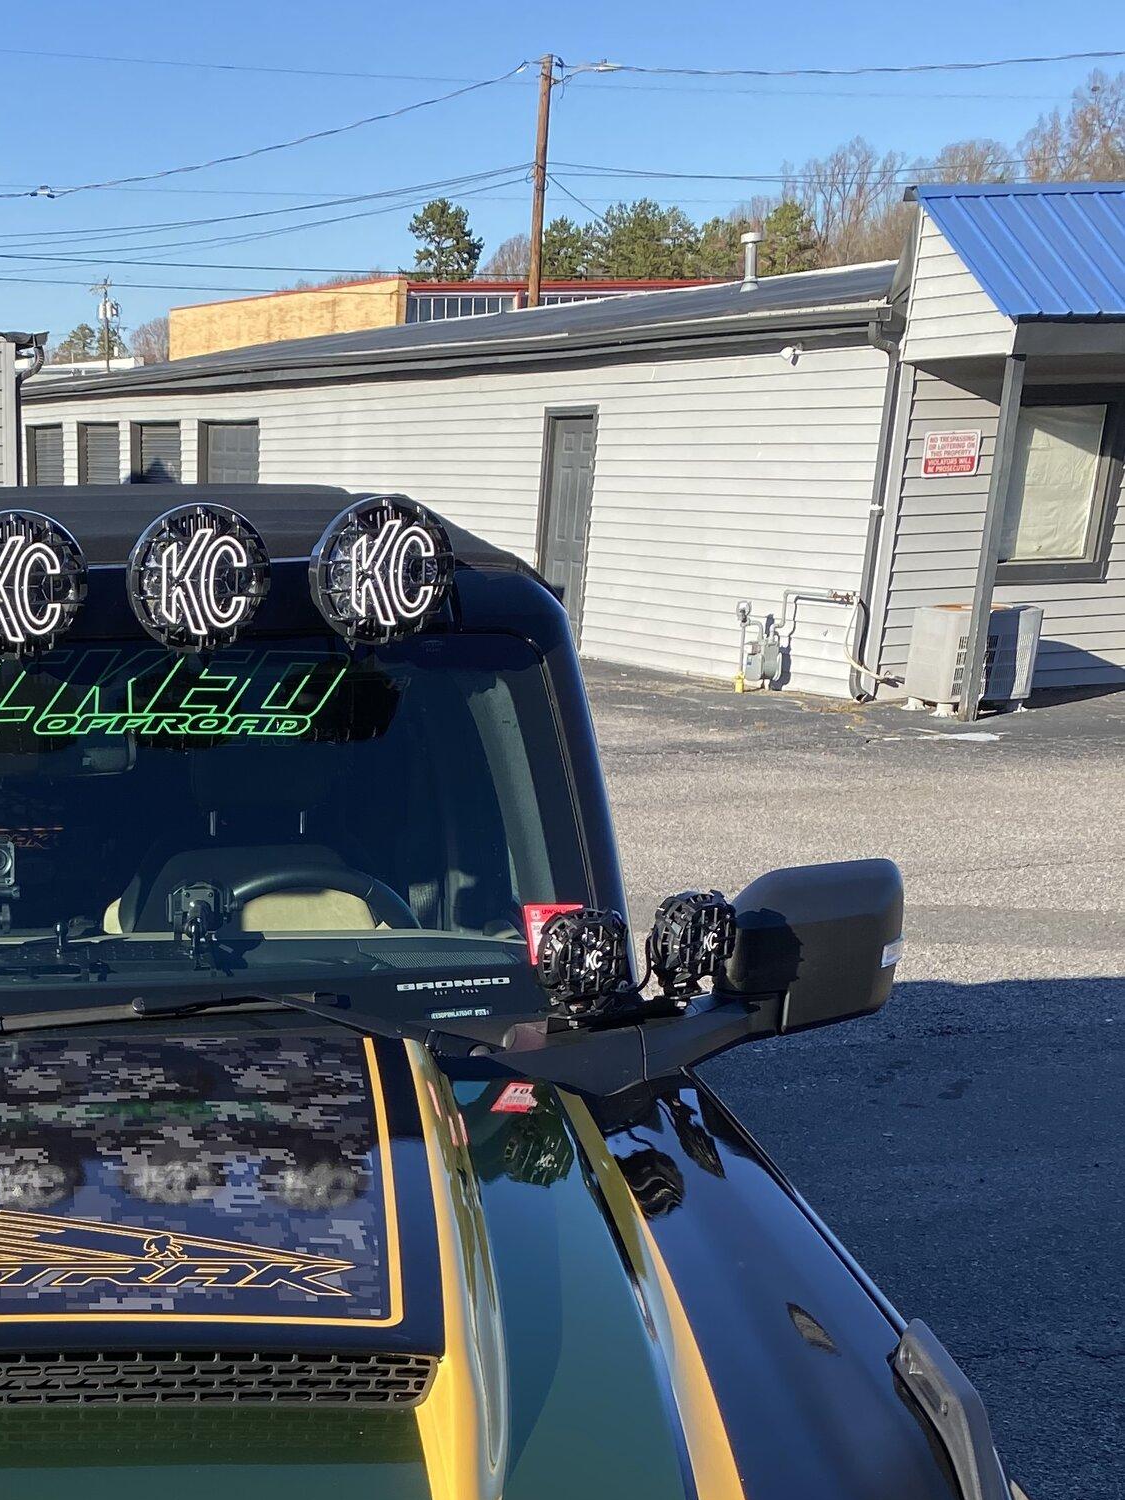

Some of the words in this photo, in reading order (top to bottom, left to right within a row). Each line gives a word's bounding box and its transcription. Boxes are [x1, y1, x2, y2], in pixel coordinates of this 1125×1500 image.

[162, 528, 248, 635] KC
[351, 519, 435, 626] KC
[34, 713, 312, 736] OFFROAD
[703, 931, 719, 951] KC
[586, 950, 603, 970] KC
[397, 977, 510, 991] BRONCO
